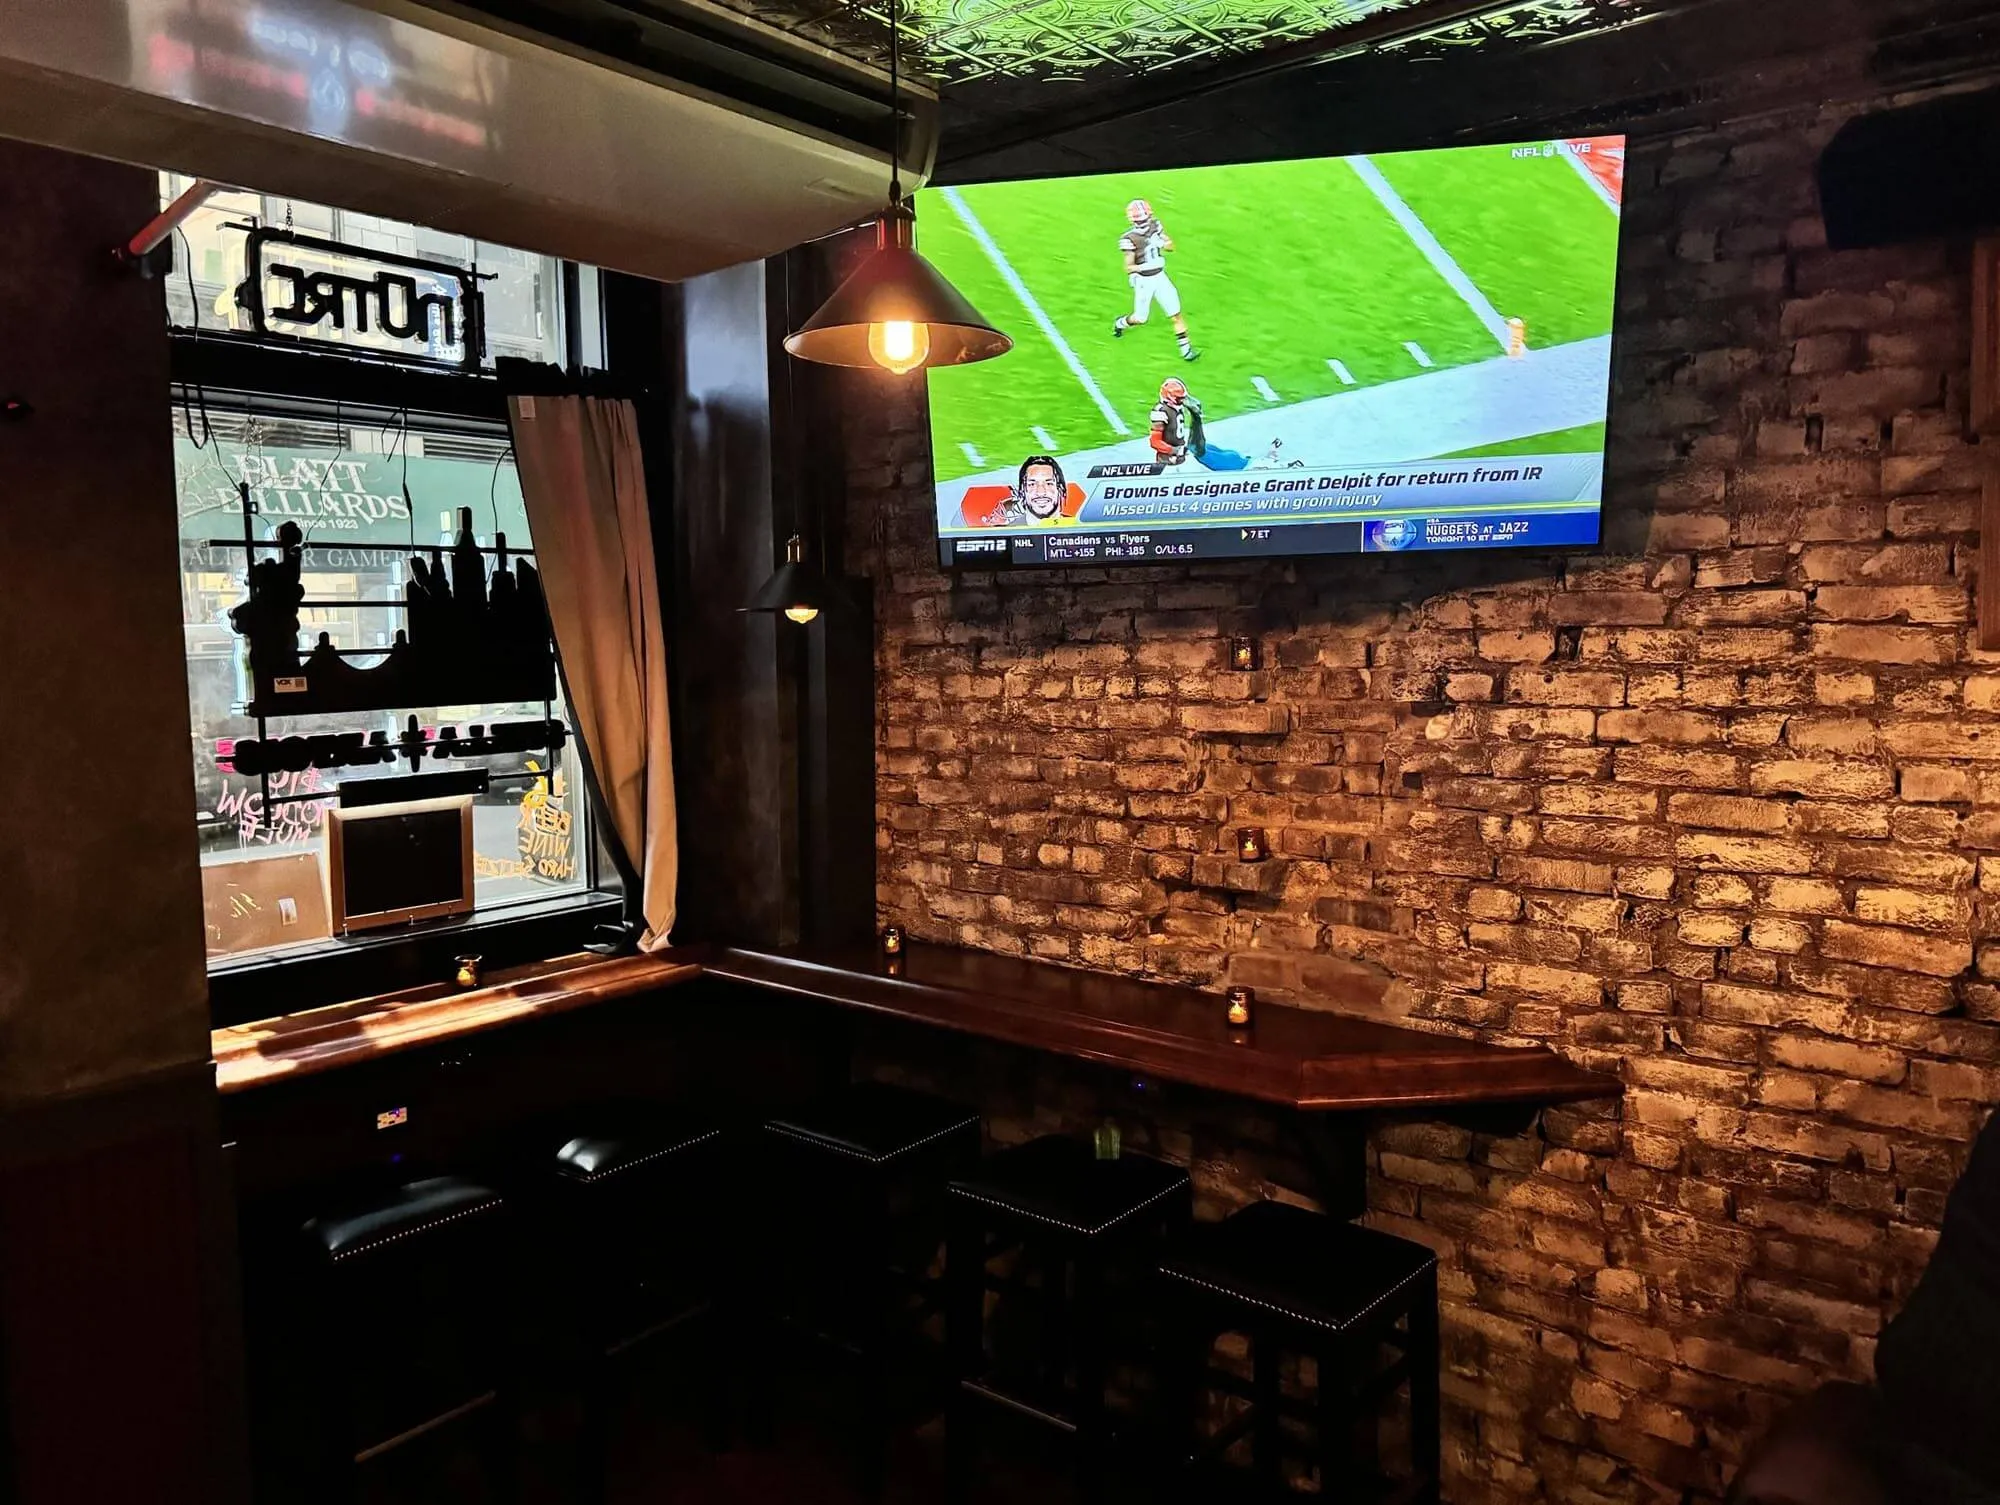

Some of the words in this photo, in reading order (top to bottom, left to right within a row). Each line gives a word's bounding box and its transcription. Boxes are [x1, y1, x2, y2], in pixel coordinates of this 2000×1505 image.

[1511, 147, 1540, 158] NFL
[1102, 466, 1124, 476] NFL
[1125, 465, 1151, 475] LIVE
[1104, 485, 1169, 499] Browns
[1173, 480, 1260, 501] designate
[1264, 477, 1314, 492] Grant
[1318, 473, 1373, 491] Delpit
[1377, 472, 1407, 488] for
[1408, 470, 1468, 485] return
[1472, 468, 1519, 482] from
[1522, 466, 1544, 480] IR
[1103, 503, 1153, 516] Missed
[1157, 500, 1186, 514] last
[1189, 500, 1199, 513] 4
[1202, 499, 1252, 515] games
[1256, 496, 1288, 510] with
[1292, 494, 1332, 509] groin
[1336, 492, 1383, 507] injury
[328, 518, 359, 529] 1923
[1426, 524, 1479, 536] NUGGETS
[1483, 526, 1494, 534] AT
[1498, 521, 1529, 533] JAZZ
[1250, 530, 1256, 538] 7
[1258, 529, 1270, 538] ET
[1426, 535, 1465, 543] TONIGHT
[1466, 534, 1477, 542] 10
[1015, 539, 1034, 547] NHL
[1049, 537, 1101, 546] Canadiens
[1120, 534, 1151, 545] Flyers
[1050, 549, 1073, 558] MTL:
[1074, 548, 1096, 557] +155
[1105, 547, 1124, 556] PHI:
[1125, 547, 1145, 556] -185
[1155, 545, 1177, 554] O/U:
[1178, 544, 1193, 553] 6.5
